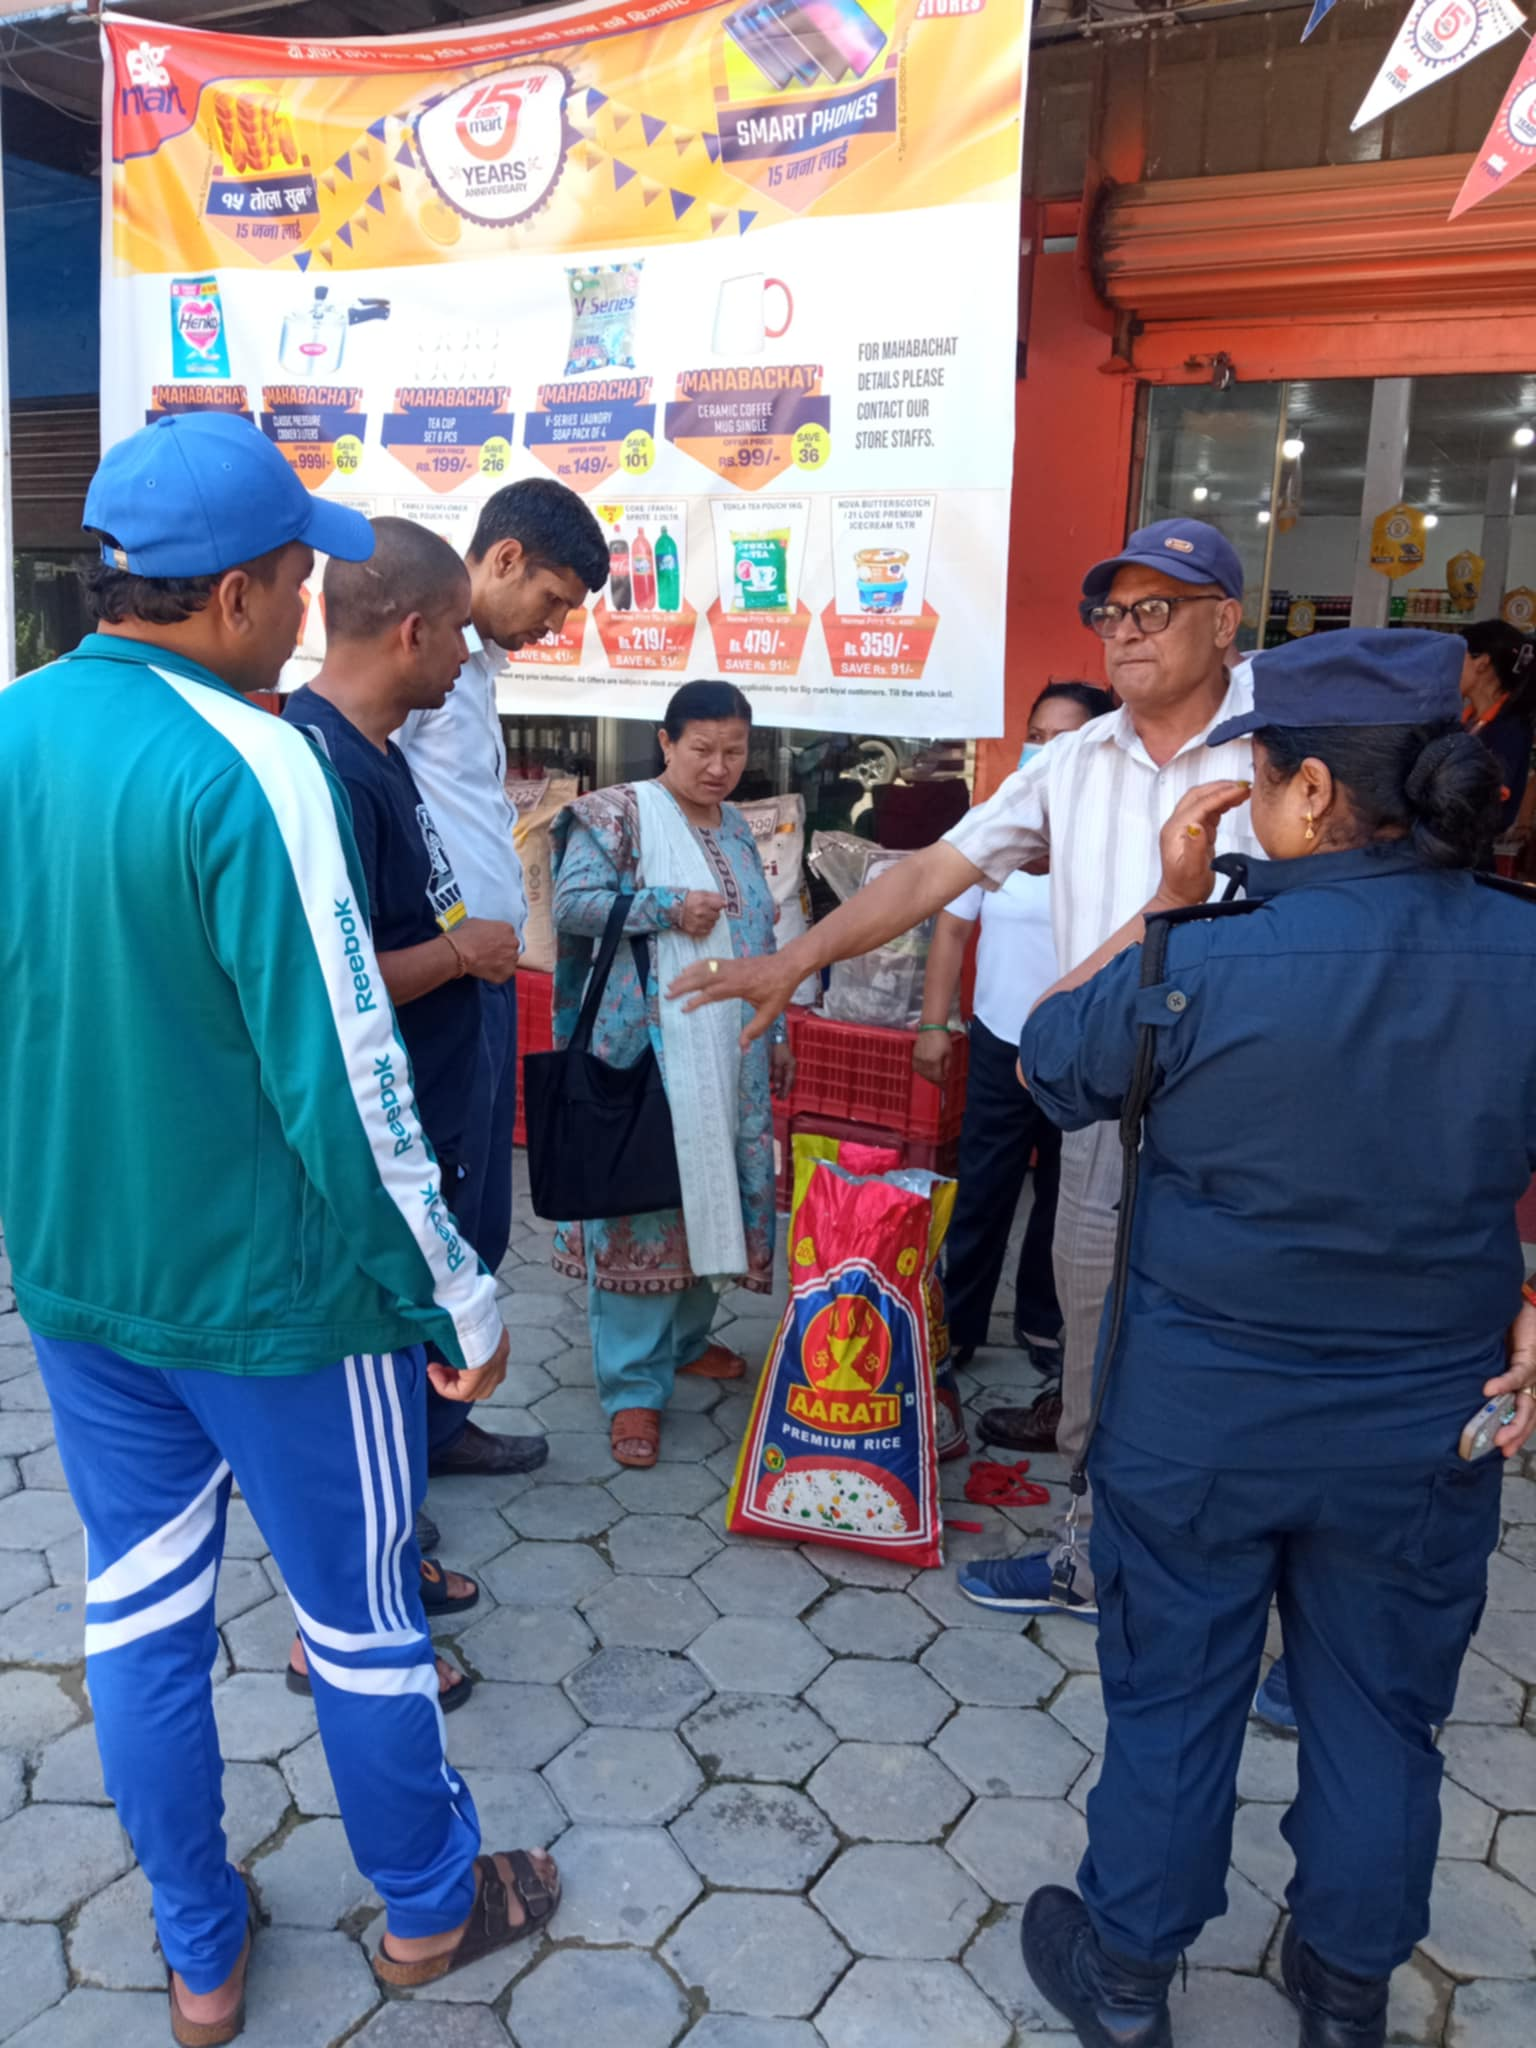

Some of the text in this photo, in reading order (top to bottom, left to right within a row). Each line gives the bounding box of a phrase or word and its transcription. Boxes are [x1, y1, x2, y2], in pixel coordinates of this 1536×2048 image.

[736, 92, 878, 146] SMART PHONES
[462, 161, 527, 185] YEARS
[768, 166, 783, 187] 15
[465, 182, 528, 197] ANNIVERSARY
[858, 336, 959, 362] FOR MAHABACHAT
[858, 367, 945, 391] DETAILS PLEASE
[698, 402, 773, 418] CERAMIC COFFEE
[857, 398, 930, 420] CONTACT OUR
[428, 417, 456, 429] TEA CUP
[581, 411, 613, 425] LAUNDRY
[714, 419, 768, 433] MUG SINGLE
[424, 431, 437, 443] SET
[444, 431, 458, 443] PCS
[552, 427, 571, 441] SOAP
[571, 427, 590, 439] PACK
[591, 426, 600, 439] OF
[797, 432, 820, 442] SAVE
[855, 428, 935, 450] STORE STAFFS.
[299, 453, 331, 470] 999/-
[336, 455, 358, 469] 676
[433, 456, 472, 472] 199/-
[625, 454, 648, 467] 101
[799, 449, 819, 463] 36
[482, 459, 504, 472] 216
[574, 457, 613, 474] 149/-
[883, 510, 922, 519] PREMIUM
[632, 627, 673, 650] 219/-
[743, 629, 785, 655] 479/-
[860, 631, 910, 657] 359/-
[514, 648, 540, 660] SAVE
[616, 655, 642, 665] SAVE
[725, 659, 752, 670] SAVE
[841, 663, 872, 674] SAVE
[334, 896, 378, 1014] Reebok
[373, 1053, 413, 1158] Reebok
[791, 1391, 896, 1424] AARATI
[782, 1422, 902, 1450] PREMIUM RICE
